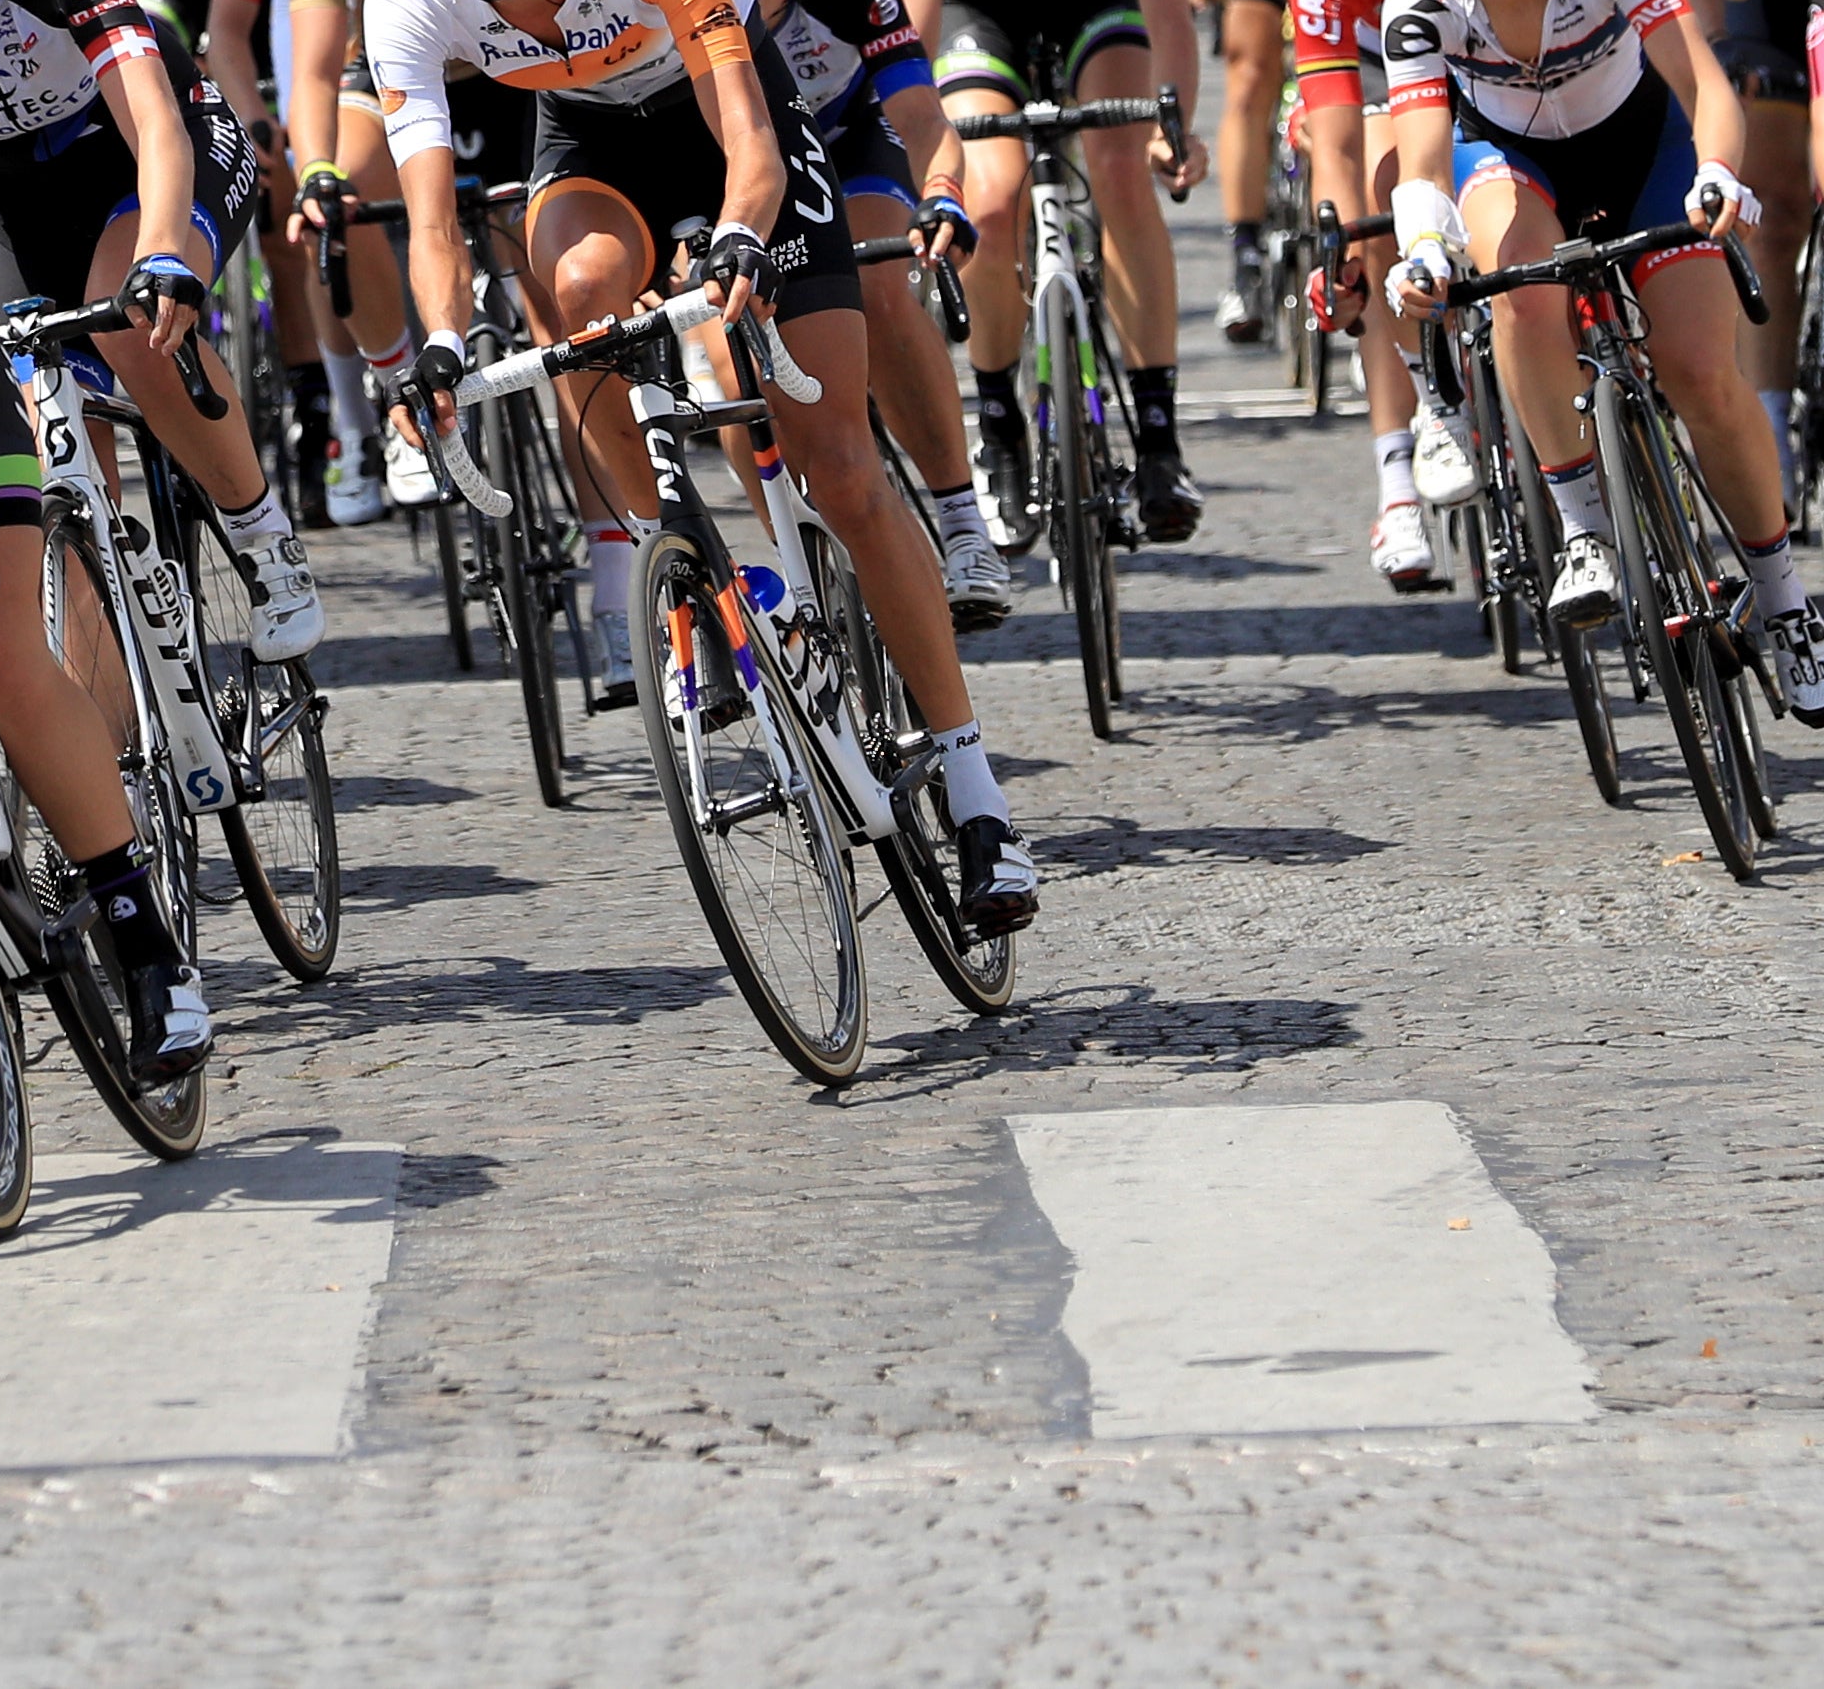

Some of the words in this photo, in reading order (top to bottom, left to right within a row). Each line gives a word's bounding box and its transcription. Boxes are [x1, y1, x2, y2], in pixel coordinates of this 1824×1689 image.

[603, 41, 642, 66] Liv
[794, 123, 834, 223] Liv
[644, 427, 685, 504] Liv
